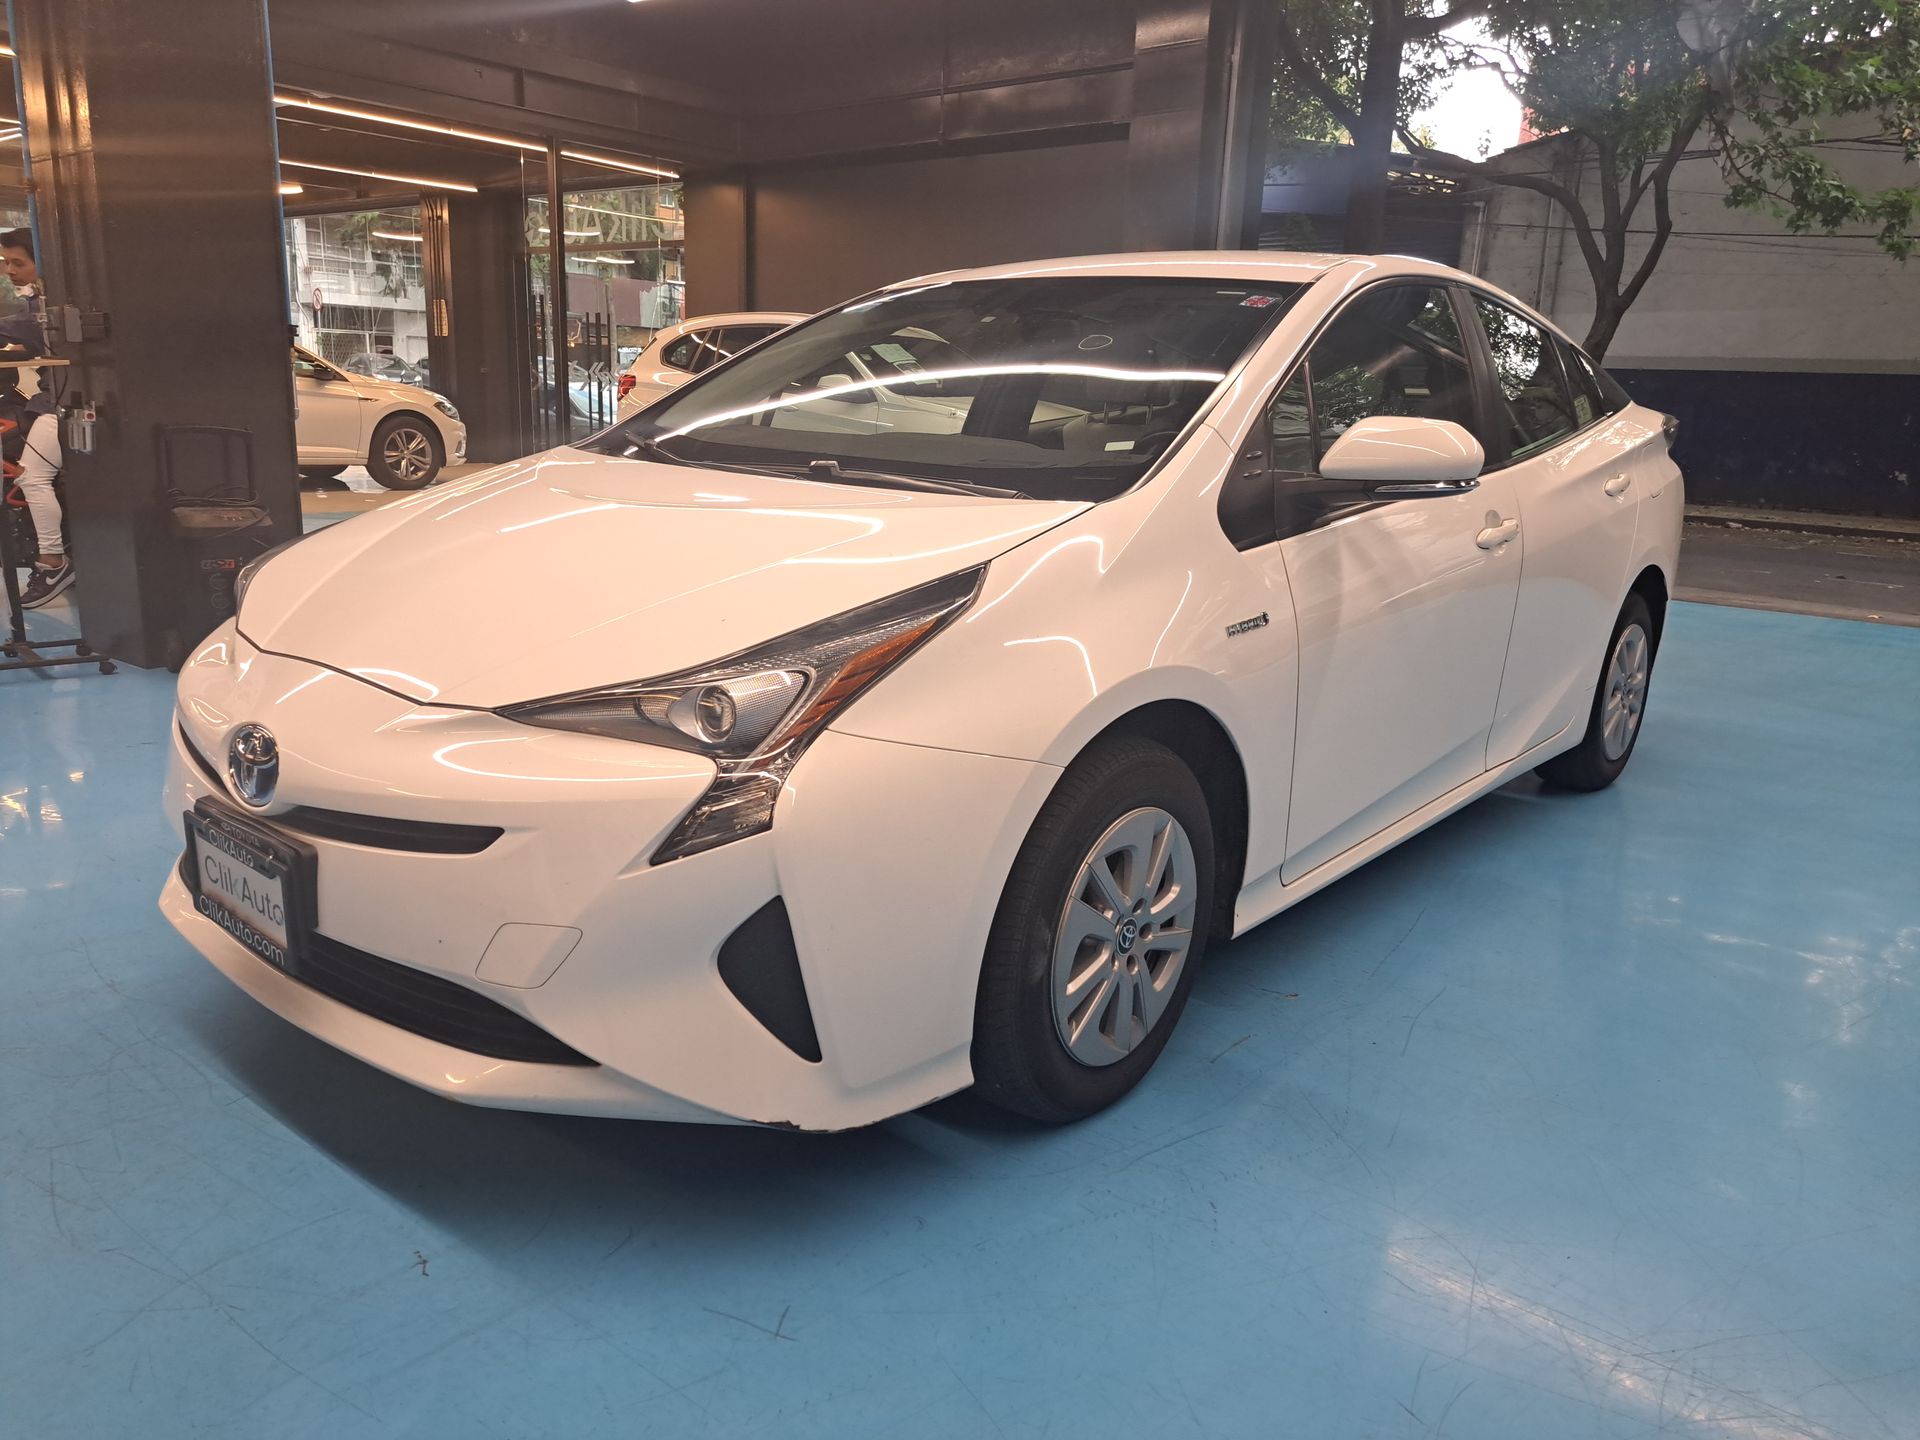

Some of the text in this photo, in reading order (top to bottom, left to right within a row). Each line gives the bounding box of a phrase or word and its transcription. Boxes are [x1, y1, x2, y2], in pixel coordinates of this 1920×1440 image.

[209, 829, 255, 867] ClikAuto
[204, 855, 285, 926] ClikAuto
[199, 894, 285, 967] ClikAuto.com
